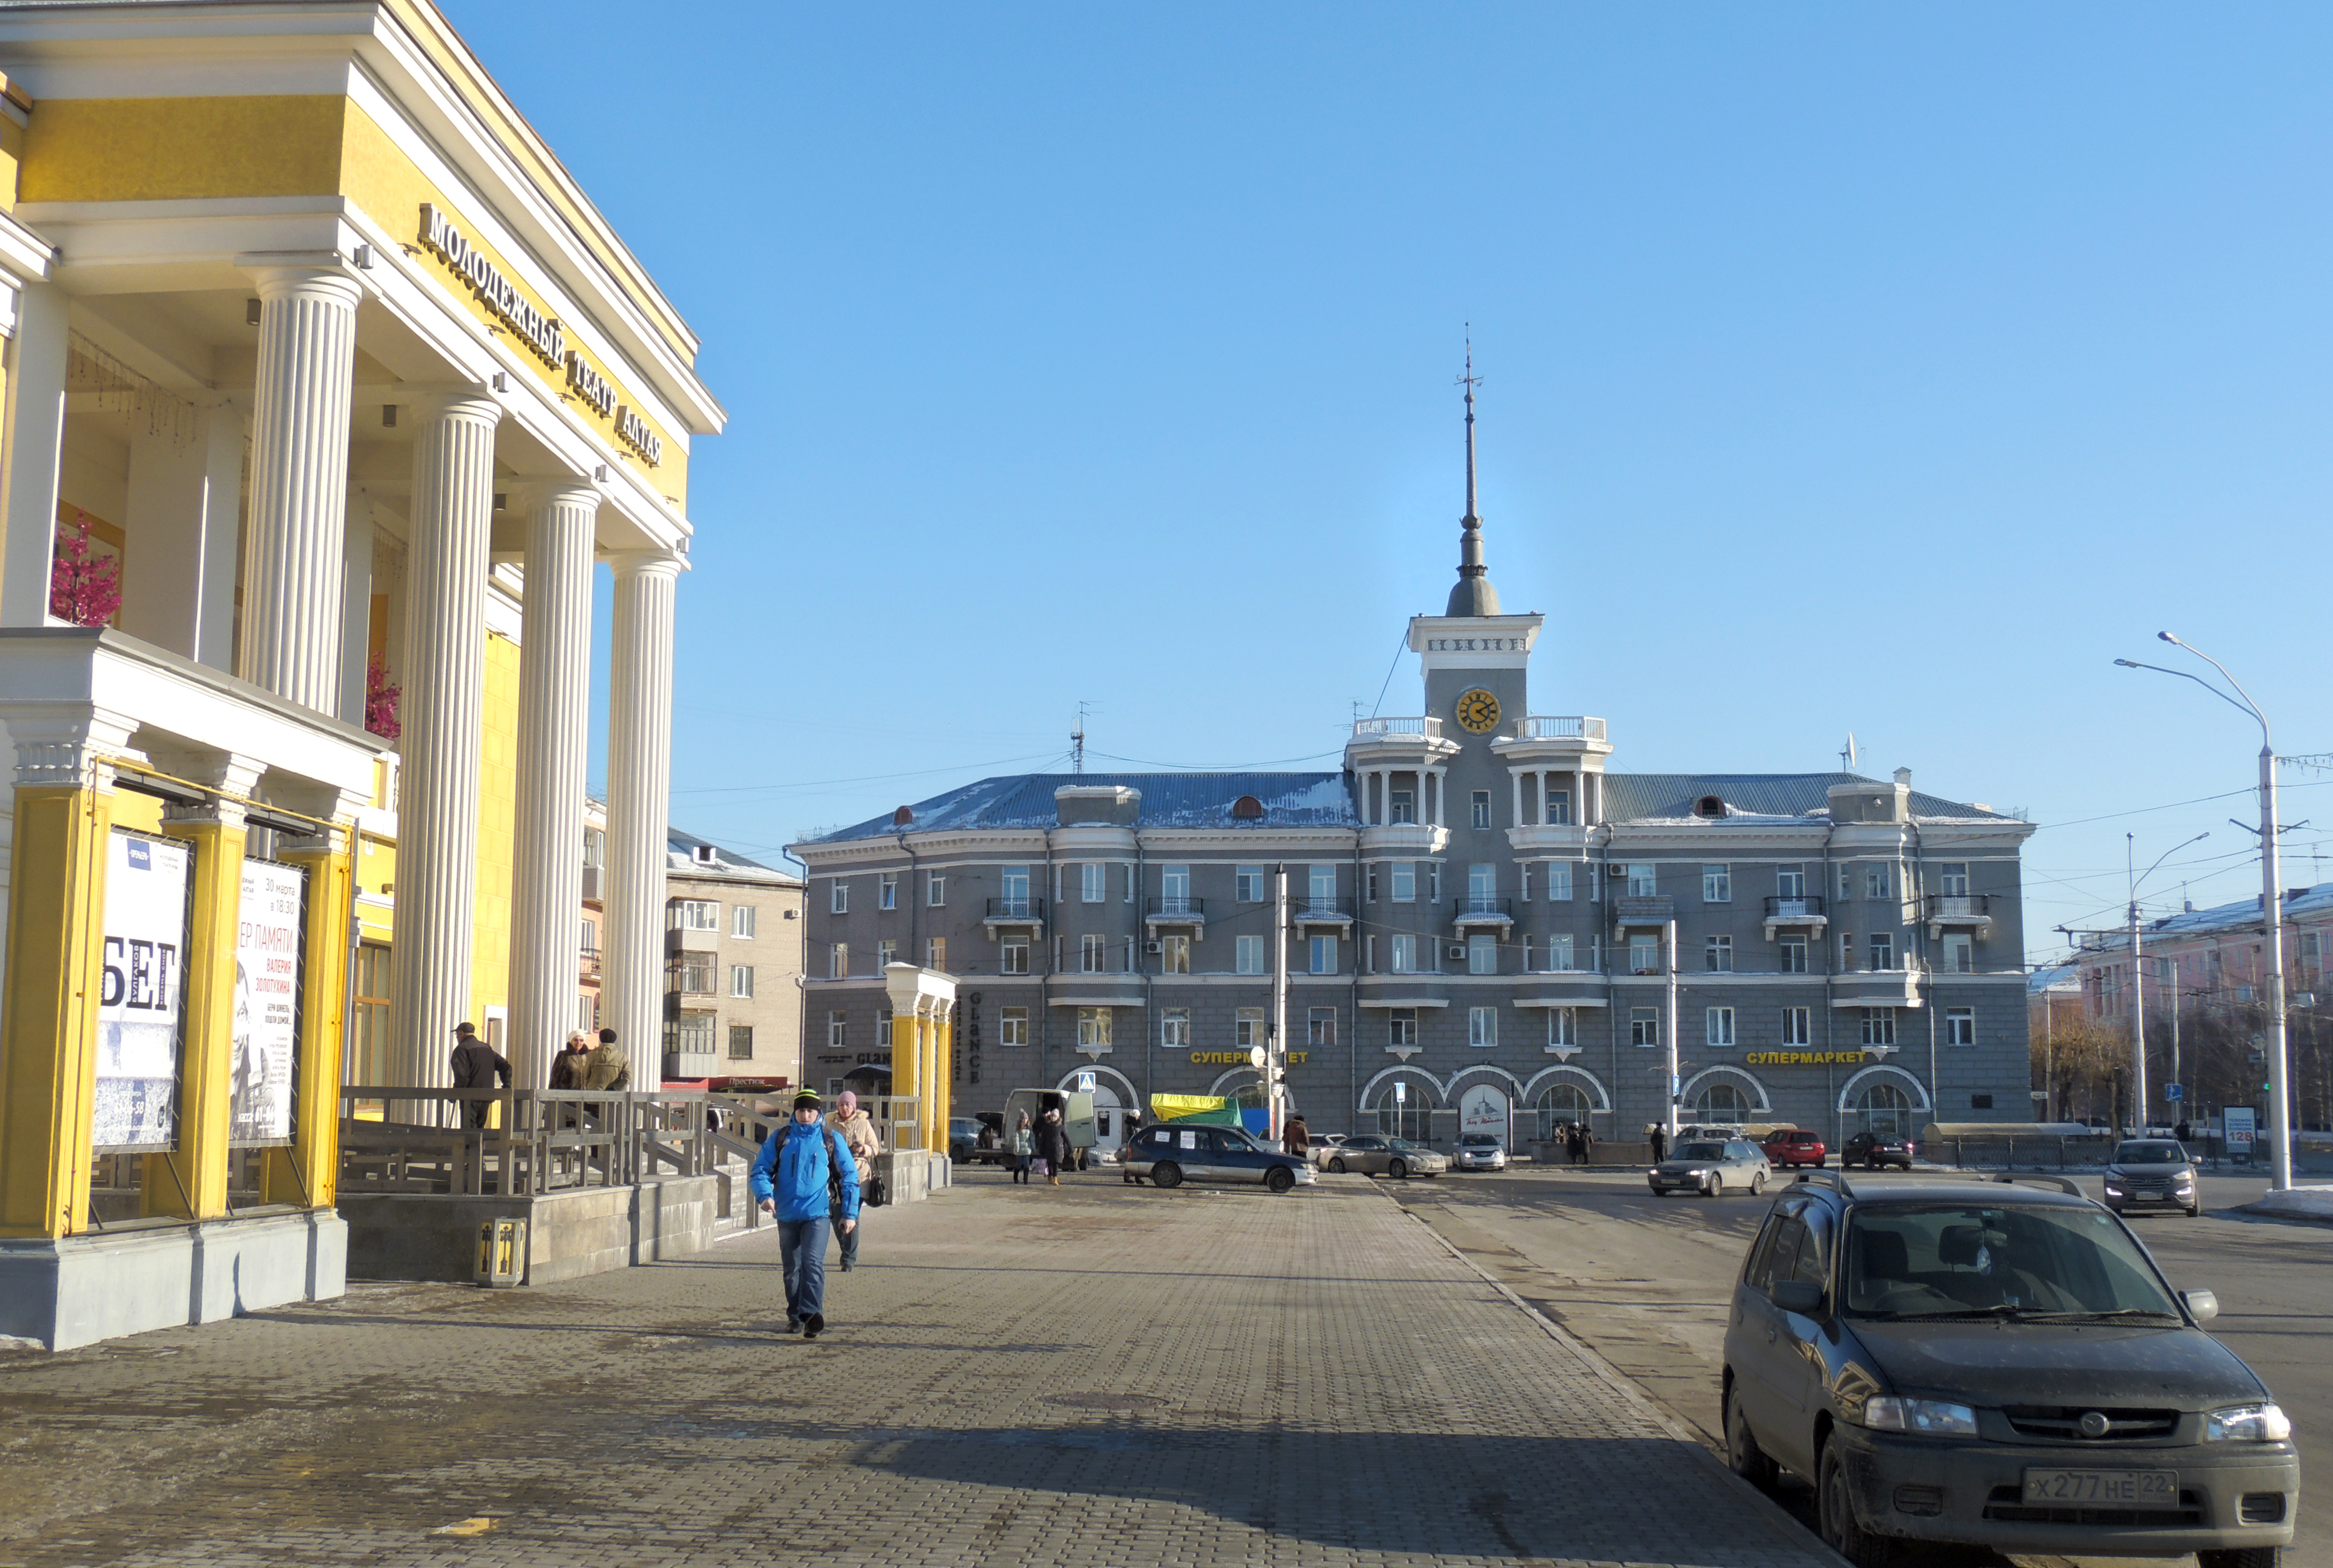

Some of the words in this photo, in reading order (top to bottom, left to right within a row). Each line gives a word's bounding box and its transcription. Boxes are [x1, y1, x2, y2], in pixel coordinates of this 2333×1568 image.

[426, 203, 566, 370] МОЛОДЕЖНЫЙ
[572, 351, 618, 418] ТЕАТР
[621, 405, 663, 469] АЛТАЯ
[265, 878, 274, 892] 30
[275, 884, 295, 898] марта
[270, 902, 274, 911] в
[276, 899, 294, 915] 18:30
[255, 924, 293, 954] ПАМЯТИ
[101, 936, 176, 1011] БЕГ
[267, 958, 291, 974] ВАЛЕРИЯ
[255, 977, 290, 994] ЗОЛОТУХИНА
[1191, 1052, 1308, 1063] СУПЕРМЕТ
[1747, 1051, 1866, 1064] СУПЕРМАРКЕТ
[2229, 1132, 2252, 1141] 128
[2143, 1475, 2166, 1492] 22
